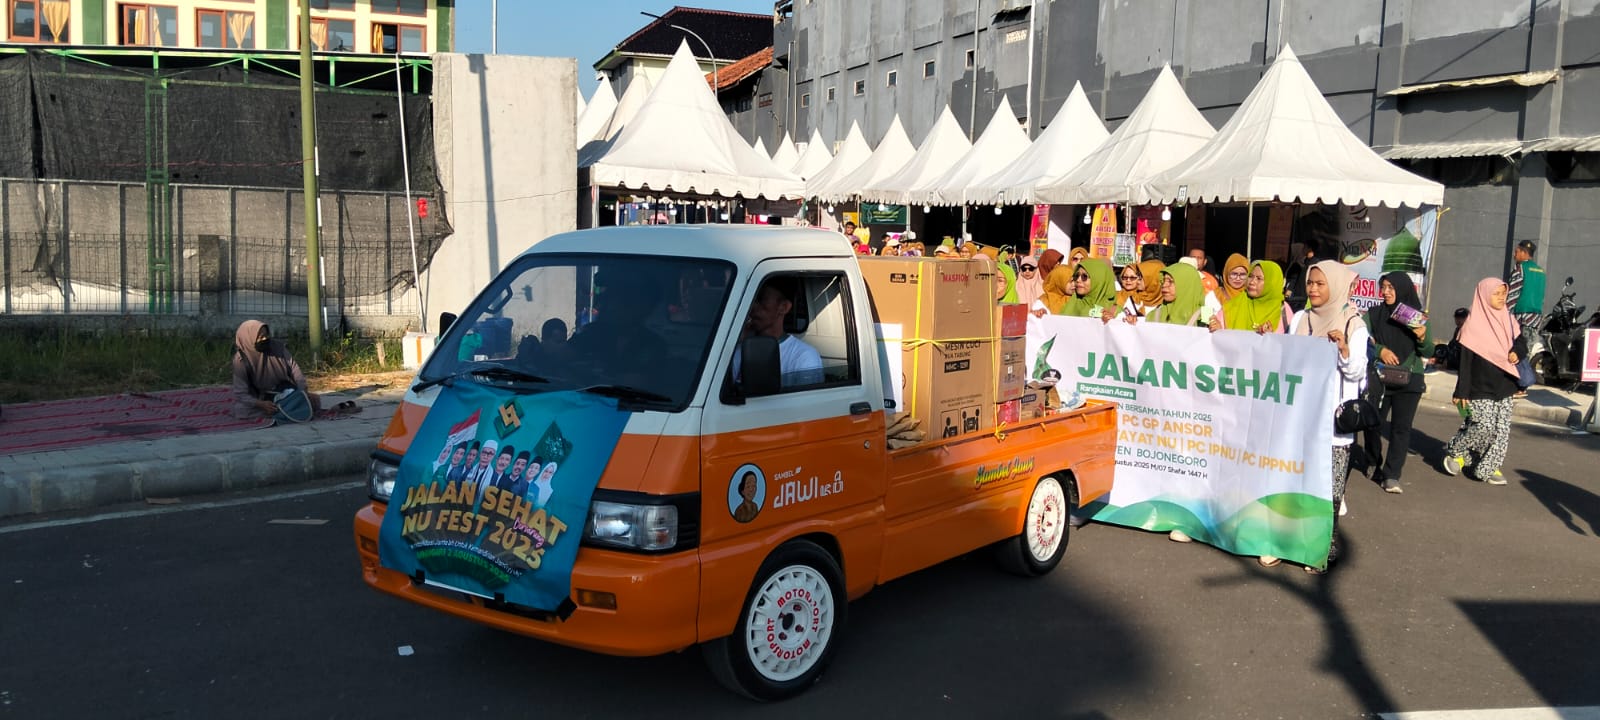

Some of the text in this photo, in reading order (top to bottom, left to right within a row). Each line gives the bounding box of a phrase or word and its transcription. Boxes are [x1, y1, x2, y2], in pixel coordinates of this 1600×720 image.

[1077, 352, 1303, 406] JALAN SEHAT
[1080, 384, 1134, 397] Rangkaian Acara
[1122, 413, 1213, 438] PC GP ANSOR
[1125, 403, 1160, 415] BERSAMA
[1161, 408, 1192, 420] TAHUN
[1193, 411, 1212, 422] 2025
[1117, 429, 1154, 445] AYAT
[1157, 435, 1177, 450] NU
[1187, 439, 1206, 454] PC
[1209, 443, 1237, 461] IPNU
[1242, 452, 1257, 466] PC
[1259, 455, 1305, 475] IPPNU
[1134, 461, 1150, 469] 2025
[1136, 448, 1208, 468] BOJONEGORO
[401, 480, 567, 545] JALAN SEHAT
[402, 509, 546, 570] NU FEST 2025
[767, 617, 811, 660] MOTORSPORT
